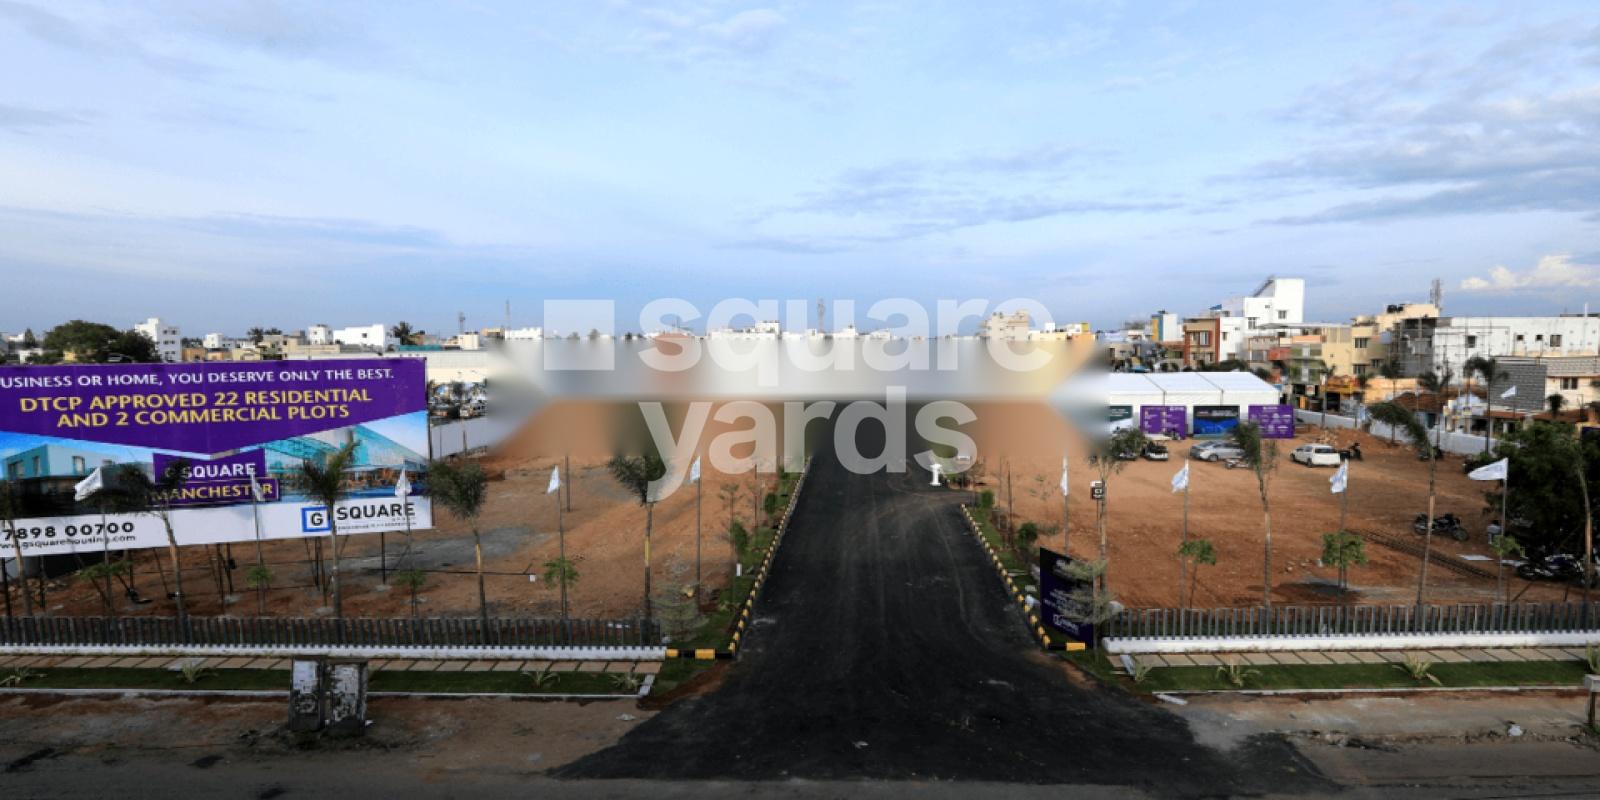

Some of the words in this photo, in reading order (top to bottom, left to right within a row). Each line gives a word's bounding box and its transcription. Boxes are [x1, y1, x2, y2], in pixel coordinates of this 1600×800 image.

[0, 375, 72, 389] USINESS
[77, 374, 103, 387] OR
[107, 373, 163, 387] HOME,
[168, 372, 203, 385] YOU
[208, 371, 275, 383] DESERVE
[279, 369, 320, 381] ONLY
[324, 368, 353, 380] THE
[357, 368, 395, 379] BEST.
[20, 396, 82, 412] DTCP
[89, 393, 207, 410] APPROVED
[214, 391, 239, 406] 22
[244, 388, 373, 405] RESIDENTIAL
[57, 412, 109, 428] AND
[115, 411, 129, 426] 2
[135, 406, 281, 425] COMMERCIAL
[288, 404, 350, 420] PLOTS
[311, 512, 324, 526] G
[336, 501, 416, 520] SQUARE
[2, 525, 57, 541] 7898
[65, 522, 134, 536] 00700
